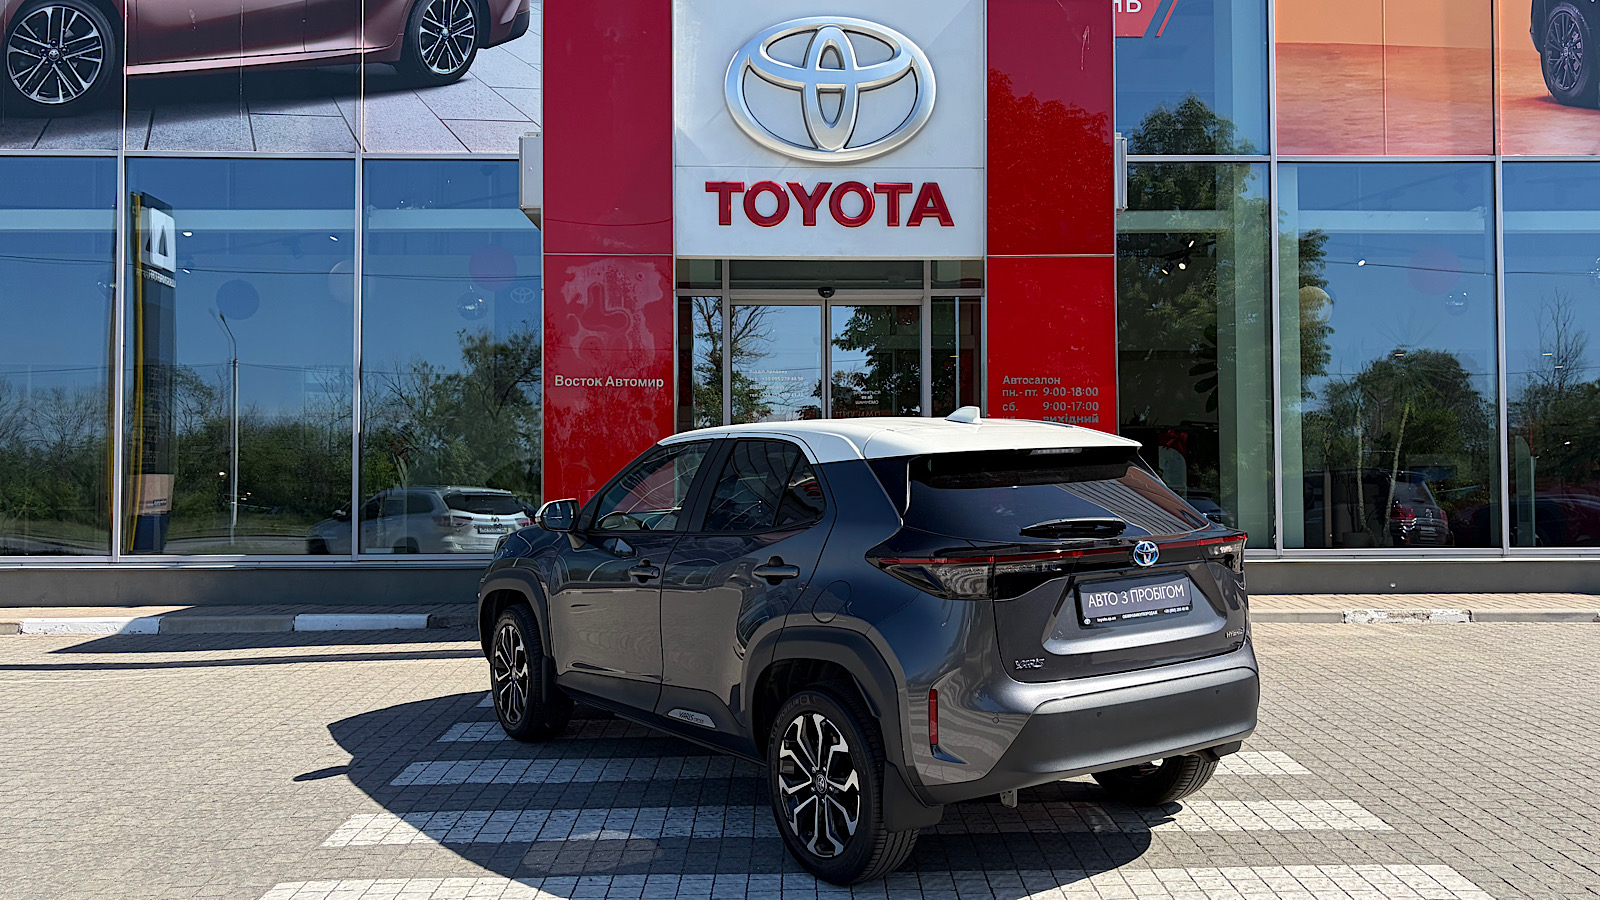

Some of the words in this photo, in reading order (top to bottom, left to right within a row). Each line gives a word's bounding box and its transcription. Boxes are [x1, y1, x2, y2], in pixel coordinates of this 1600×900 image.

[705, 181, 955, 227] TOYOTA
[555, 375, 603, 387] Восток
[605, 375, 664, 390] Автомир
[1002, 375, 1061, 385] Автосалон
[1002, 402, 1019, 411] сб.
[1088, 592, 1119, 608] АВТО
[1130, 584, 1185, 603] ПРОБІГОМ
